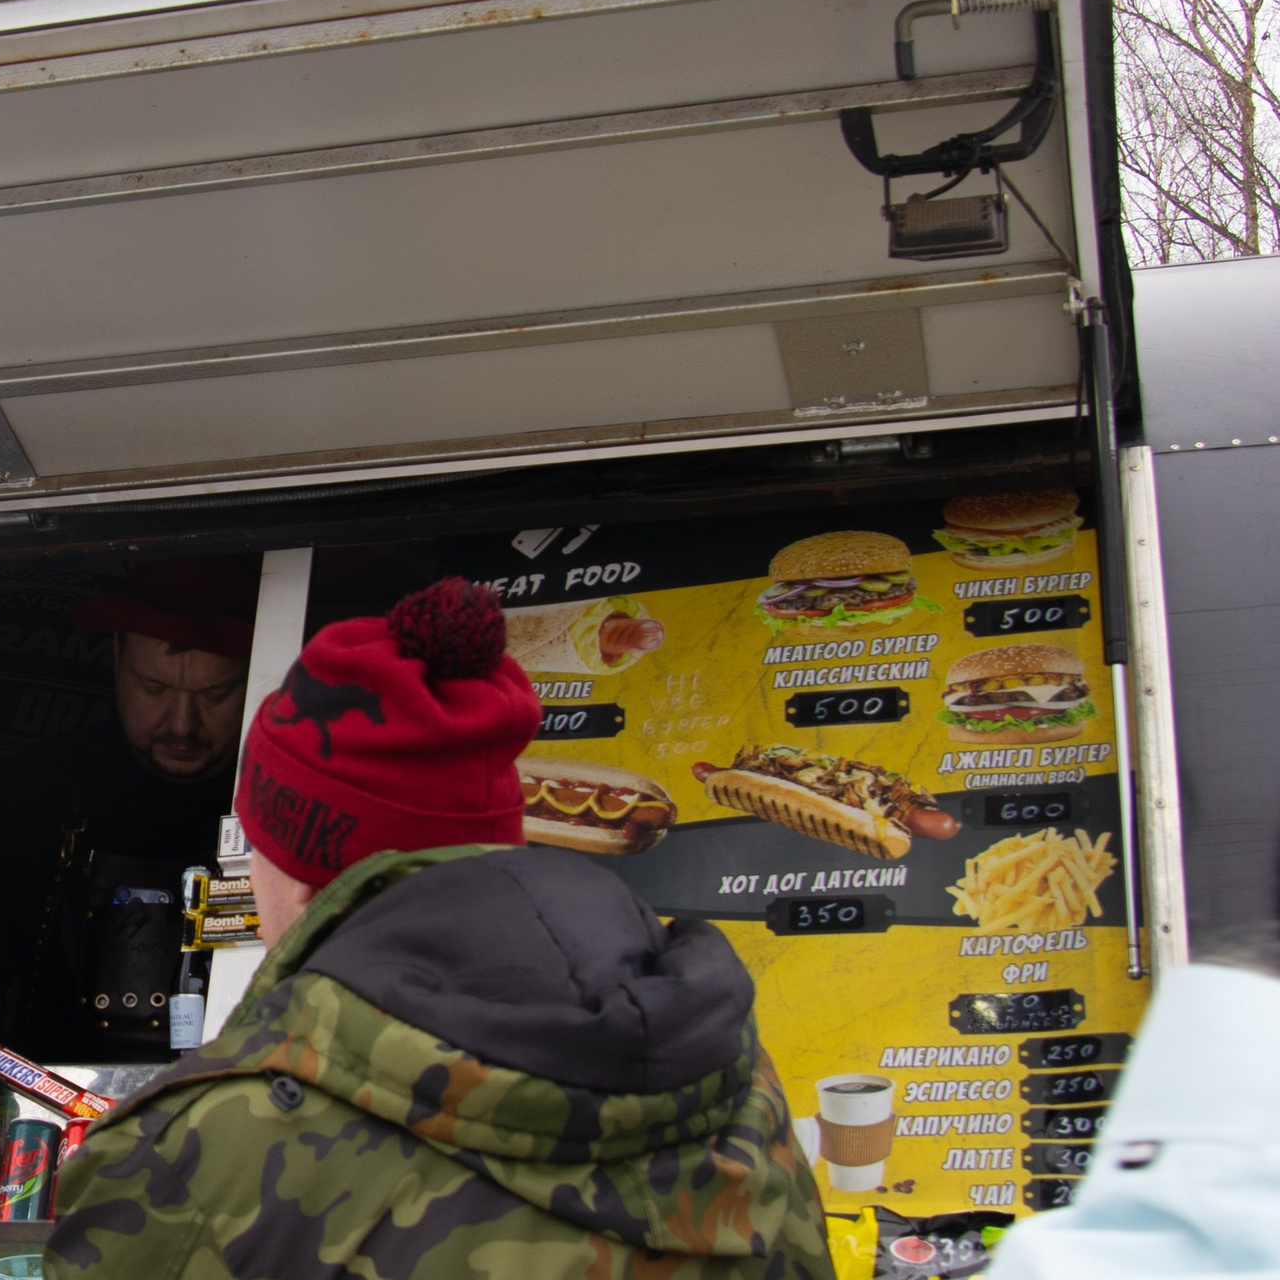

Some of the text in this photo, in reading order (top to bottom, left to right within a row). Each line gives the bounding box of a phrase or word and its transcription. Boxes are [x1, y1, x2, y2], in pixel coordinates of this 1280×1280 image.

[565, 561, 641, 591] FOOD
[953, 572, 1093, 599] ЧИКЕН БУРГЕР
[1000, 607, 1063, 630] 500
[762, 634, 939, 665] MEATFOOD БУРГЕР
[773, 659, 930, 689] КЛАССИЧЕСКИЙ
[814, 697, 884, 719] 500
[938, 743, 1112, 774] ДЖАНГЛ БУРГЕР
[965, 768, 1086, 789] (АНАНАСИК BBQ)
[1001, 803, 1064, 820] 600
[718, 865, 908, 895] ХОТ ДОГ ДАТСКИЙ
[797, 902, 858, 927] 350
[959, 929, 1088, 957] КАРТОФЕЛЬ
[1001, 961, 1049, 984] ФРИ
[879, 1044, 1012, 1068] АМЕРИКАНО
[1047, 1044, 1093, 1061] 250
[36, 1076, 76, 1105] SUPER
[903, 1079, 1013, 1103] ЭСПРЕССО
[1053, 1077, 1097, 1095] 250
[895, 1113, 1013, 1137] КАПУЧИНО
[941, 1148, 1015, 1170] ЛАТТЕ
[969, 1181, 1016, 1206] ЧАЙ
